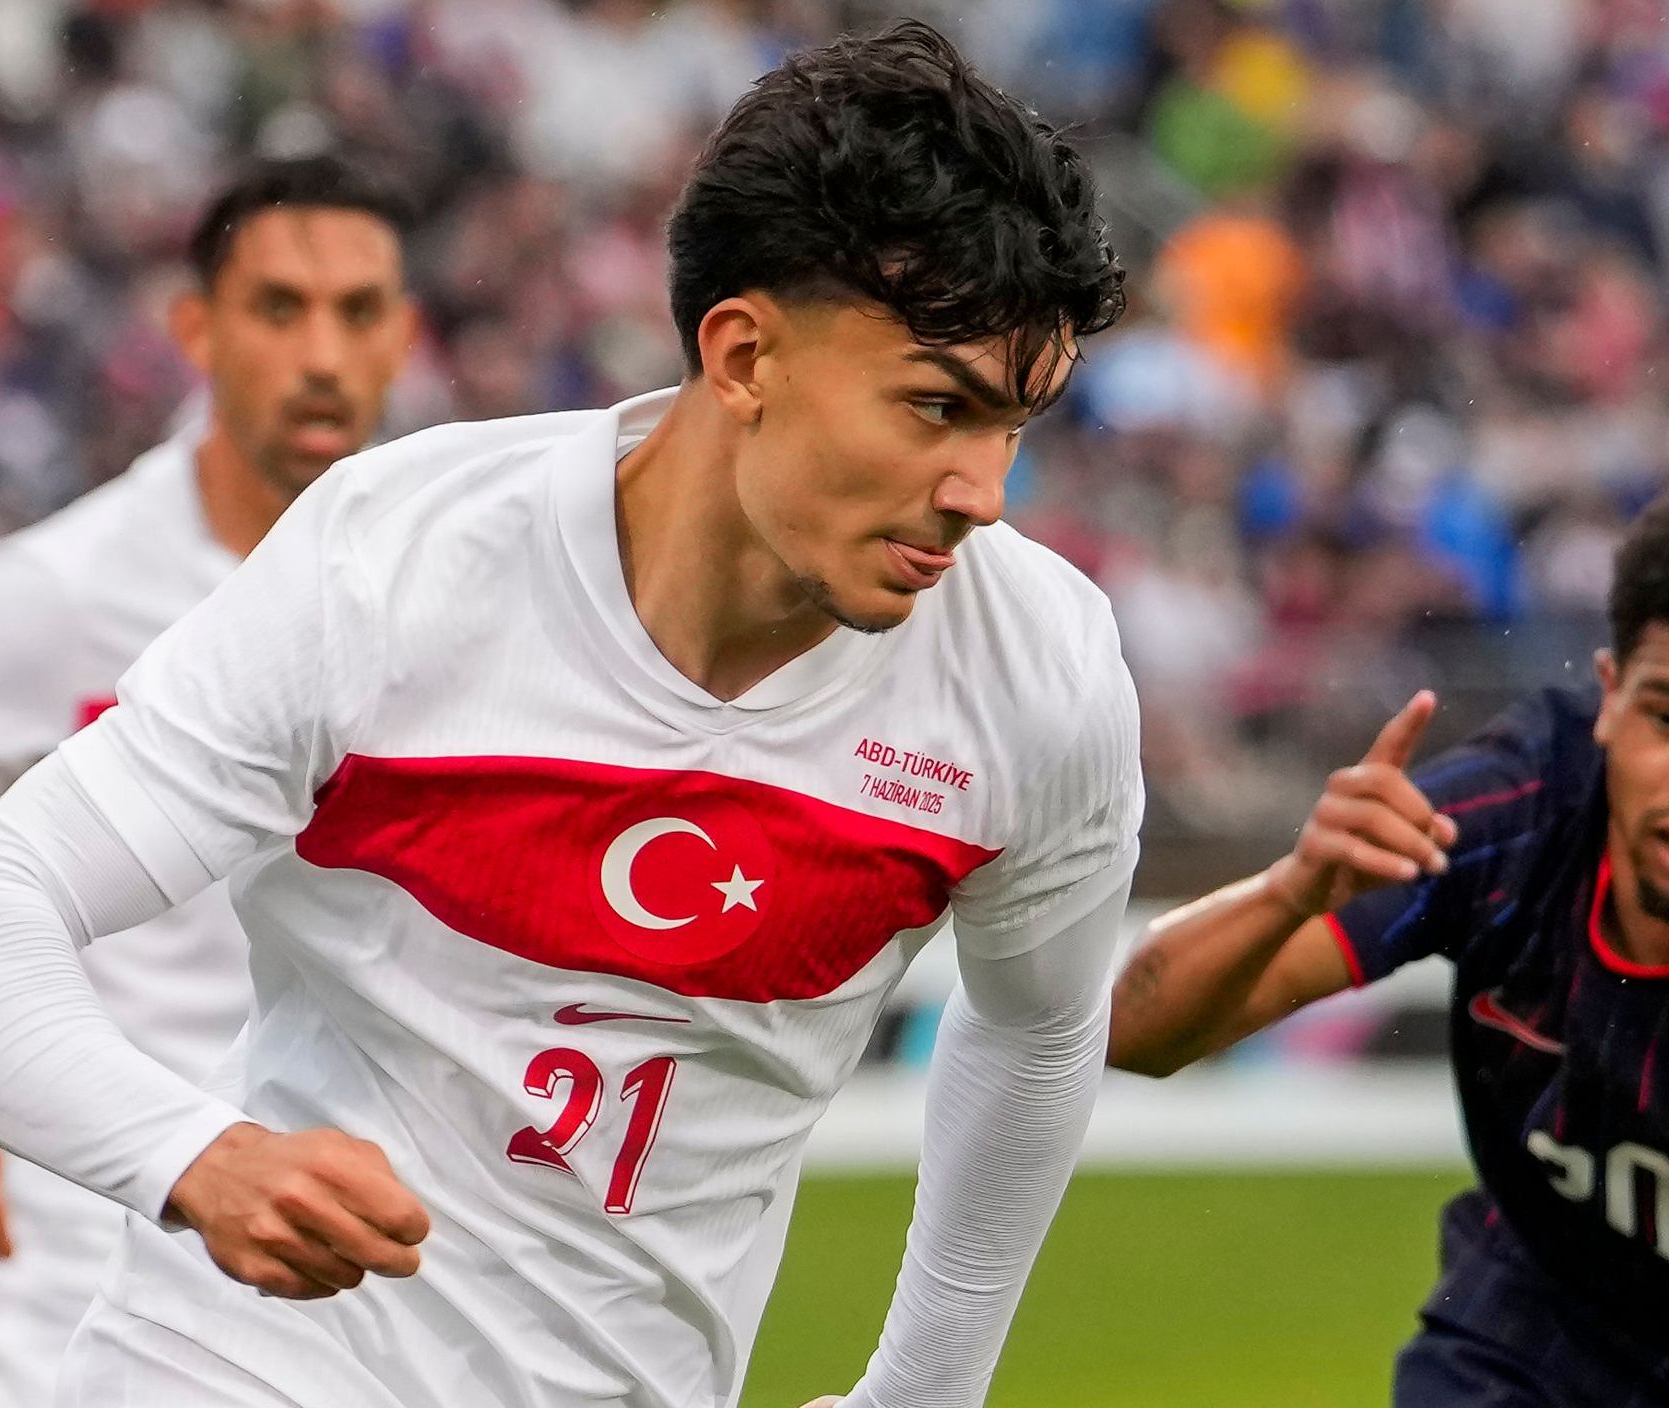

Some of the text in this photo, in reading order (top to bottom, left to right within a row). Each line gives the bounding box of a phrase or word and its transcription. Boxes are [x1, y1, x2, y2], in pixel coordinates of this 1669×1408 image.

[854, 738, 974, 791] ABD-TÜRKİYE
[860, 774, 945, 815] 7 HAZİRAN 2025
[506, 1047, 677, 1214] 21
